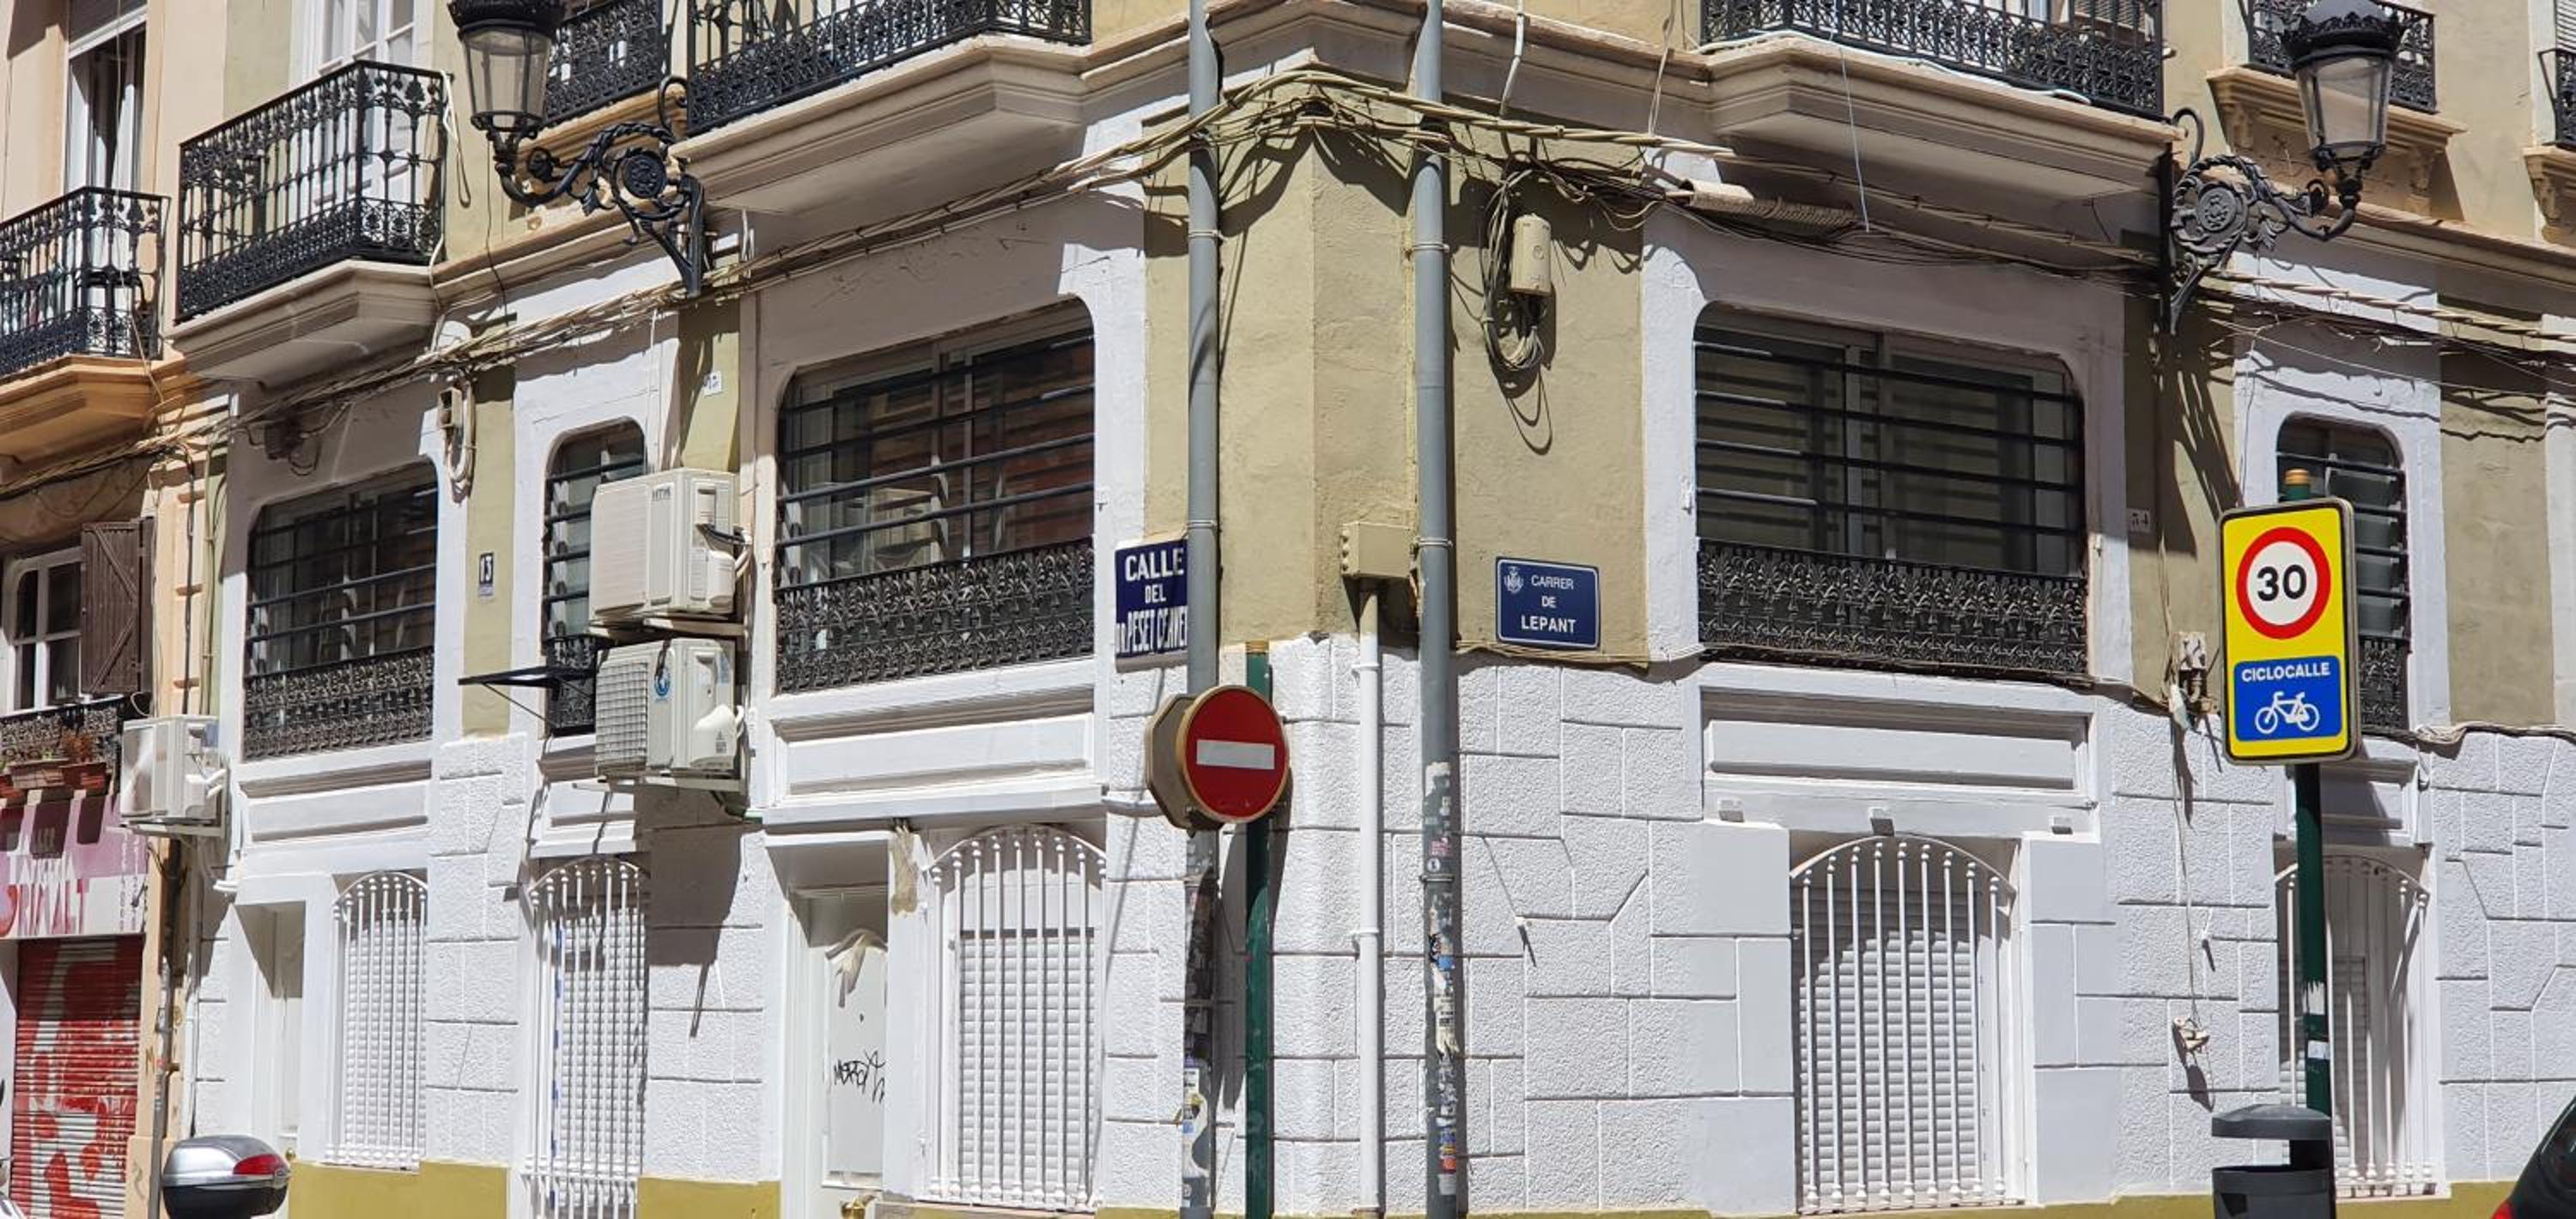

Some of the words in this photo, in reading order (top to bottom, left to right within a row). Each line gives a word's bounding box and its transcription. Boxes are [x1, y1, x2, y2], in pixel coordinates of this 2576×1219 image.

[1125, 548, 1184, 580] CALLE
[1531, 574, 1574, 590] CARRER
[2257, 564, 2307, 602] 30
[1145, 585, 1166, 603] DEL
[1541, 595, 1557, 609] DE
[1521, 614, 1577, 634] LEPANT
[2240, 661, 2331, 682] CICLOCALLE
